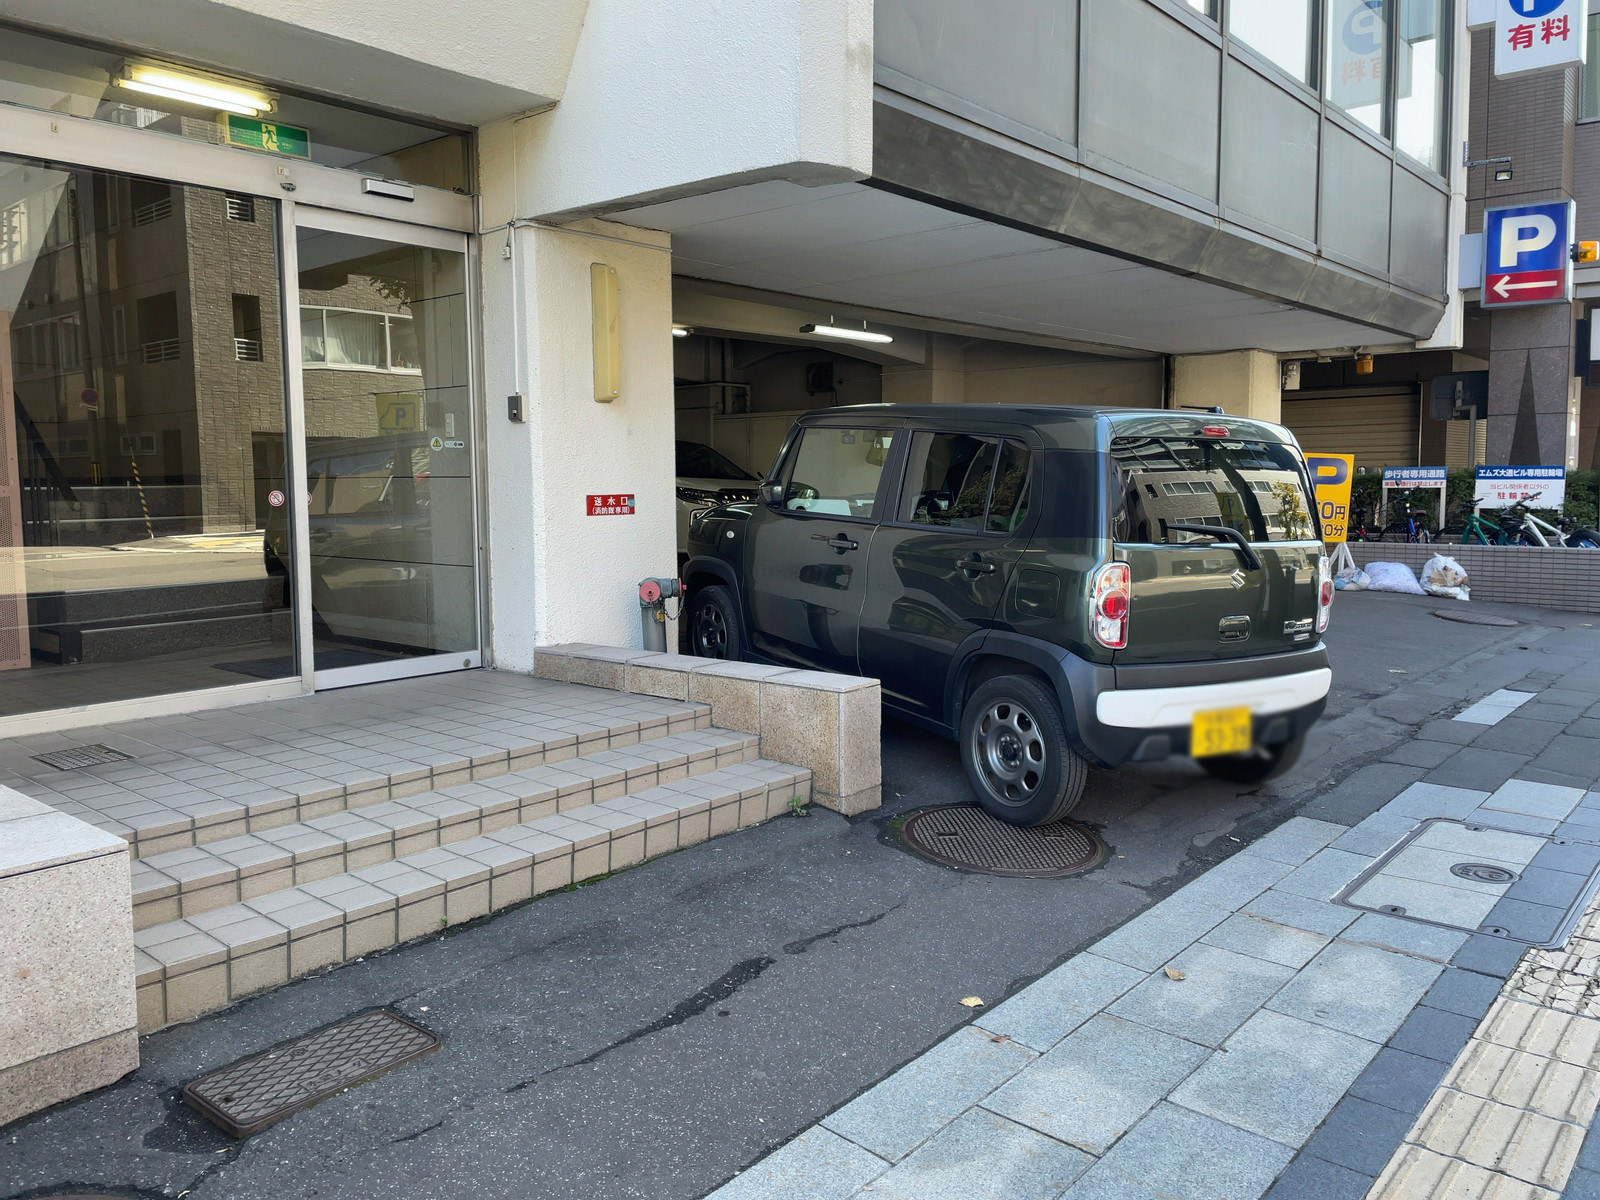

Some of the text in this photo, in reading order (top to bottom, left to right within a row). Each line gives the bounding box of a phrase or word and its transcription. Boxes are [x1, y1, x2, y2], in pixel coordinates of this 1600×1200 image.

[1508, 14, 1571, 51] 有料
[1500, 214, 1556, 268] P
[1307, 456, 1348, 495] P
[1384, 469, 1445, 479] 歩行者専用通路
[1478, 468, 1563, 477] エムズ大通ビル専用駐輪場
[593, 496, 628, 507] 送水口
[1317, 501, 1346, 520] 0円
[1322, 523, 1344, 537] 0分
